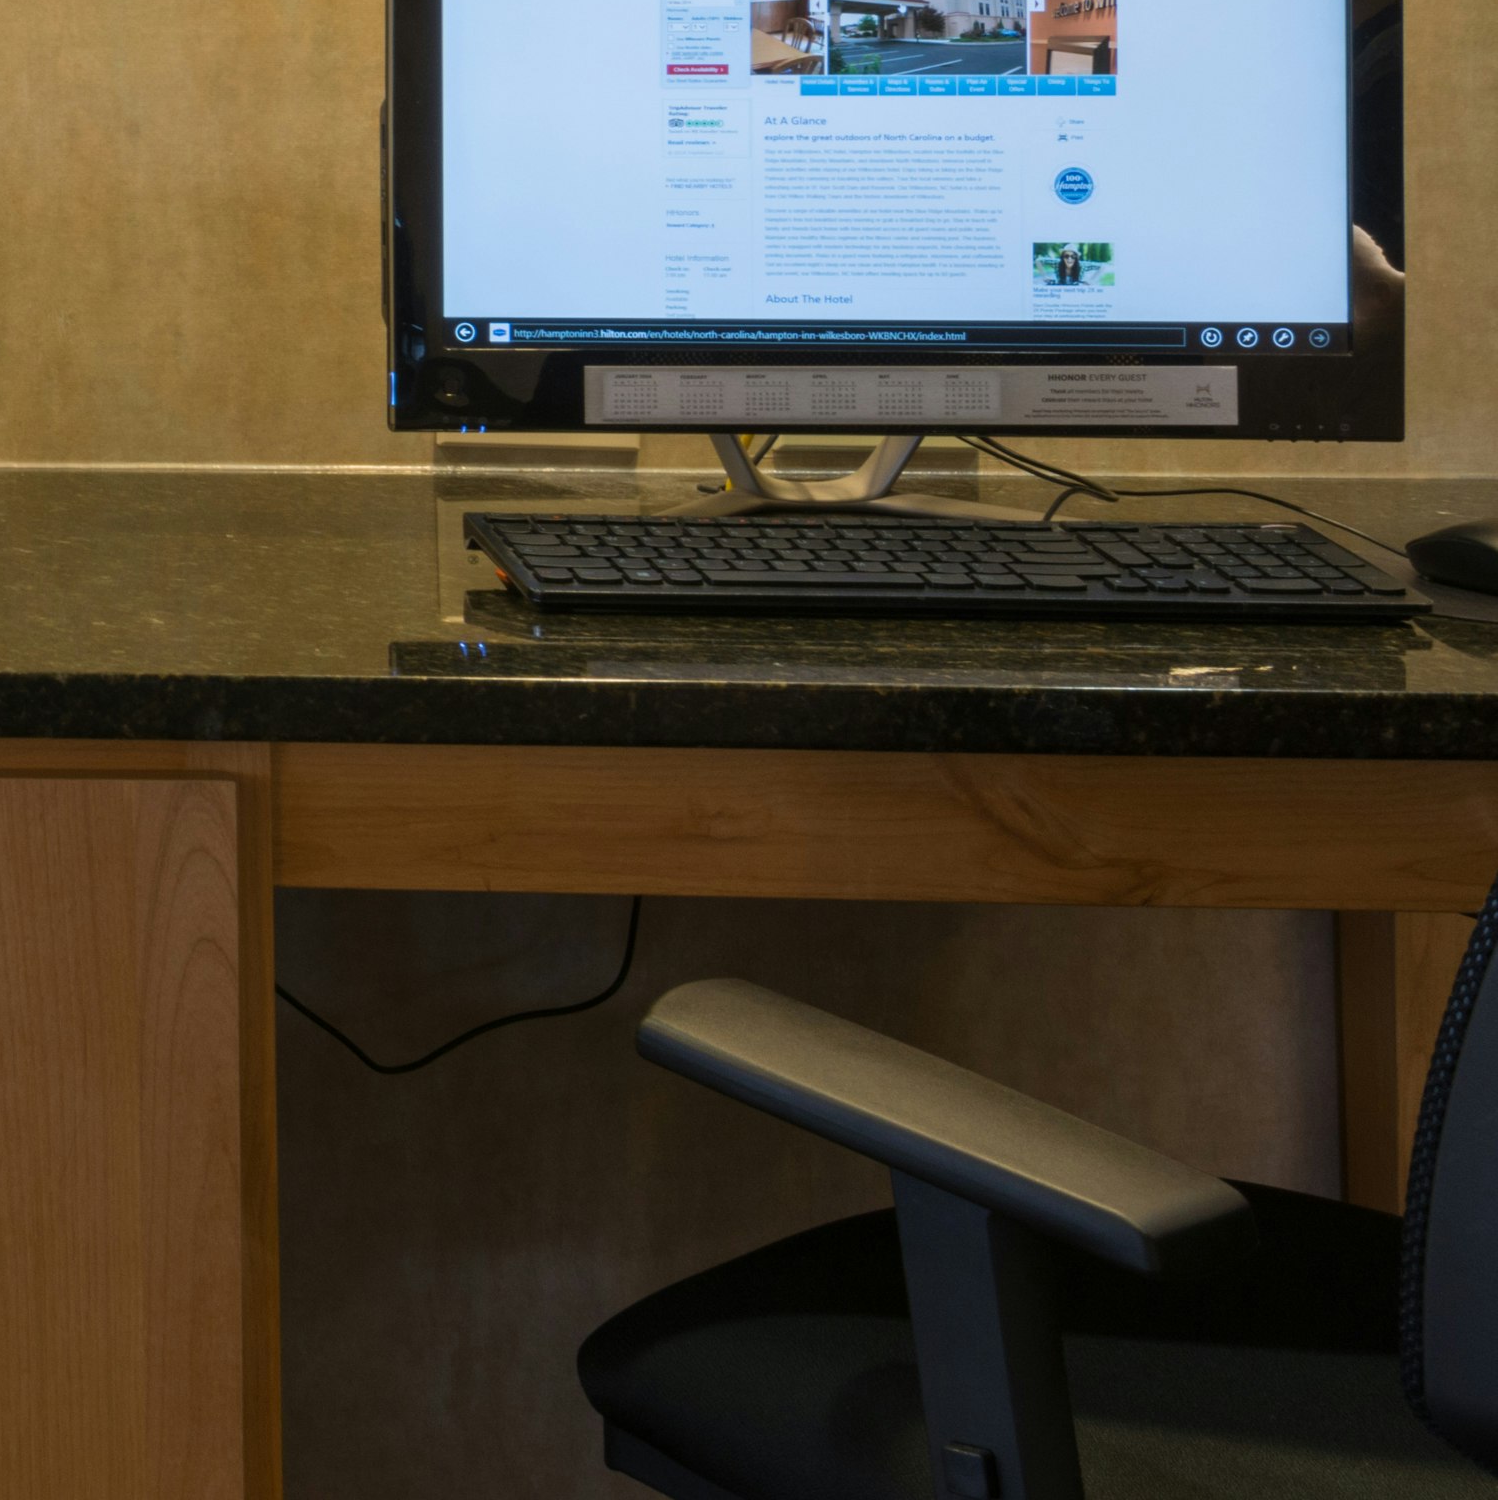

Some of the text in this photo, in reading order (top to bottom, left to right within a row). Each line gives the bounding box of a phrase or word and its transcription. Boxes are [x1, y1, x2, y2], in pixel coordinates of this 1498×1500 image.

[765, 116, 776, 125] At
[791, 116, 826, 125] Glance
[964, 134, 996, 143] budget.
[1056, 181, 1092, 191] Hampton
[766, 294, 853, 304] About The Hotel
[514, 329, 966, 341] http://hamptoninn3.hilton.com/en/hotels/north-carolina/hampton-inn-wilkesboro-WKBNCHX/index.html
[1089, 373, 1115, 382] EVERY
[1118, 373, 1146, 382] GUEST
